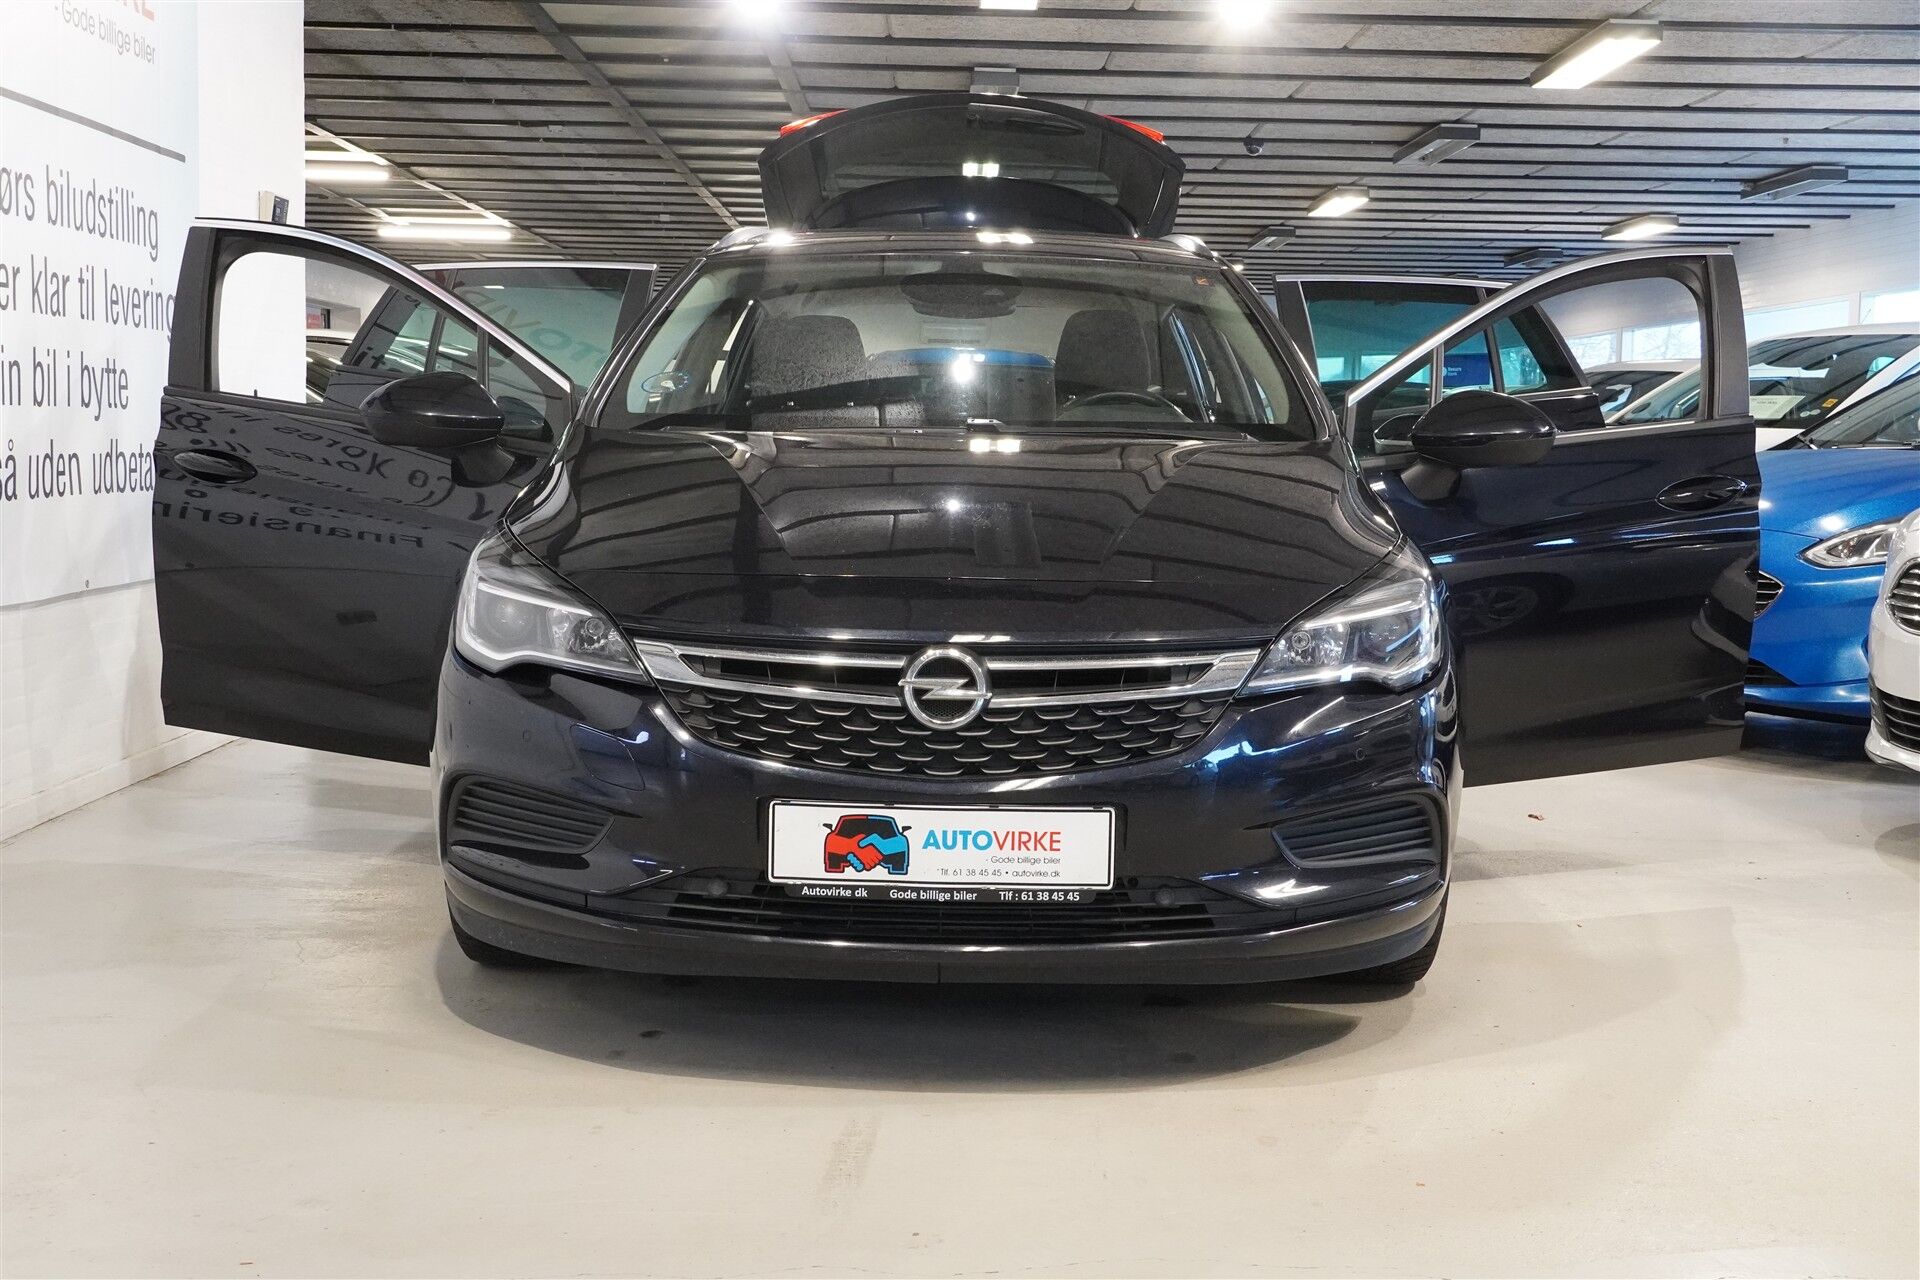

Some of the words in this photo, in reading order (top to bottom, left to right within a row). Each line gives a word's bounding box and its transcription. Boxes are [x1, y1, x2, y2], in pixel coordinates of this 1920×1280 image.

[62, 0, 95, 35] Gode
[98, 13, 131, 56] billige
[133, 32, 155, 65] biler
[46, 164, 158, 262] biludstilling
[0, 263, 21, 312] er
[31, 254, 70, 317] klar
[78, 264, 95, 320] til
[33, 346, 57, 408] bil
[66, 350, 71, 408] i
[80, 350, 129, 421] bytte
[28, 438, 82, 500] uden
[92, 438, 154, 495] udbeta
[921, 829, 1062, 852] AUTOVIRKE
[990, 855, 1016, 864] Gode
[1017, 855, 1042, 866] billige
[1043, 856, 1061, 865] biler
[952, 868, 963, 877] 61
[965, 868, 977, 877] 38
[978, 868, 990, 877] 45
[991, 868, 1003, 877] 45
[801, 886, 852, 897] Autovirke
[854, 887, 868, 898] dk
[889, 889, 918, 899] Gode
[919, 889, 951, 902] billige
[953, 890, 978, 901] biler
[999, 891, 1013, 901] Tlf
[1021, 891, 1034, 901] 61
[1036, 891, 1050, 901] 38
[1051, 891, 1065, 901] 45
[1066, 891, 1080, 901] 45
